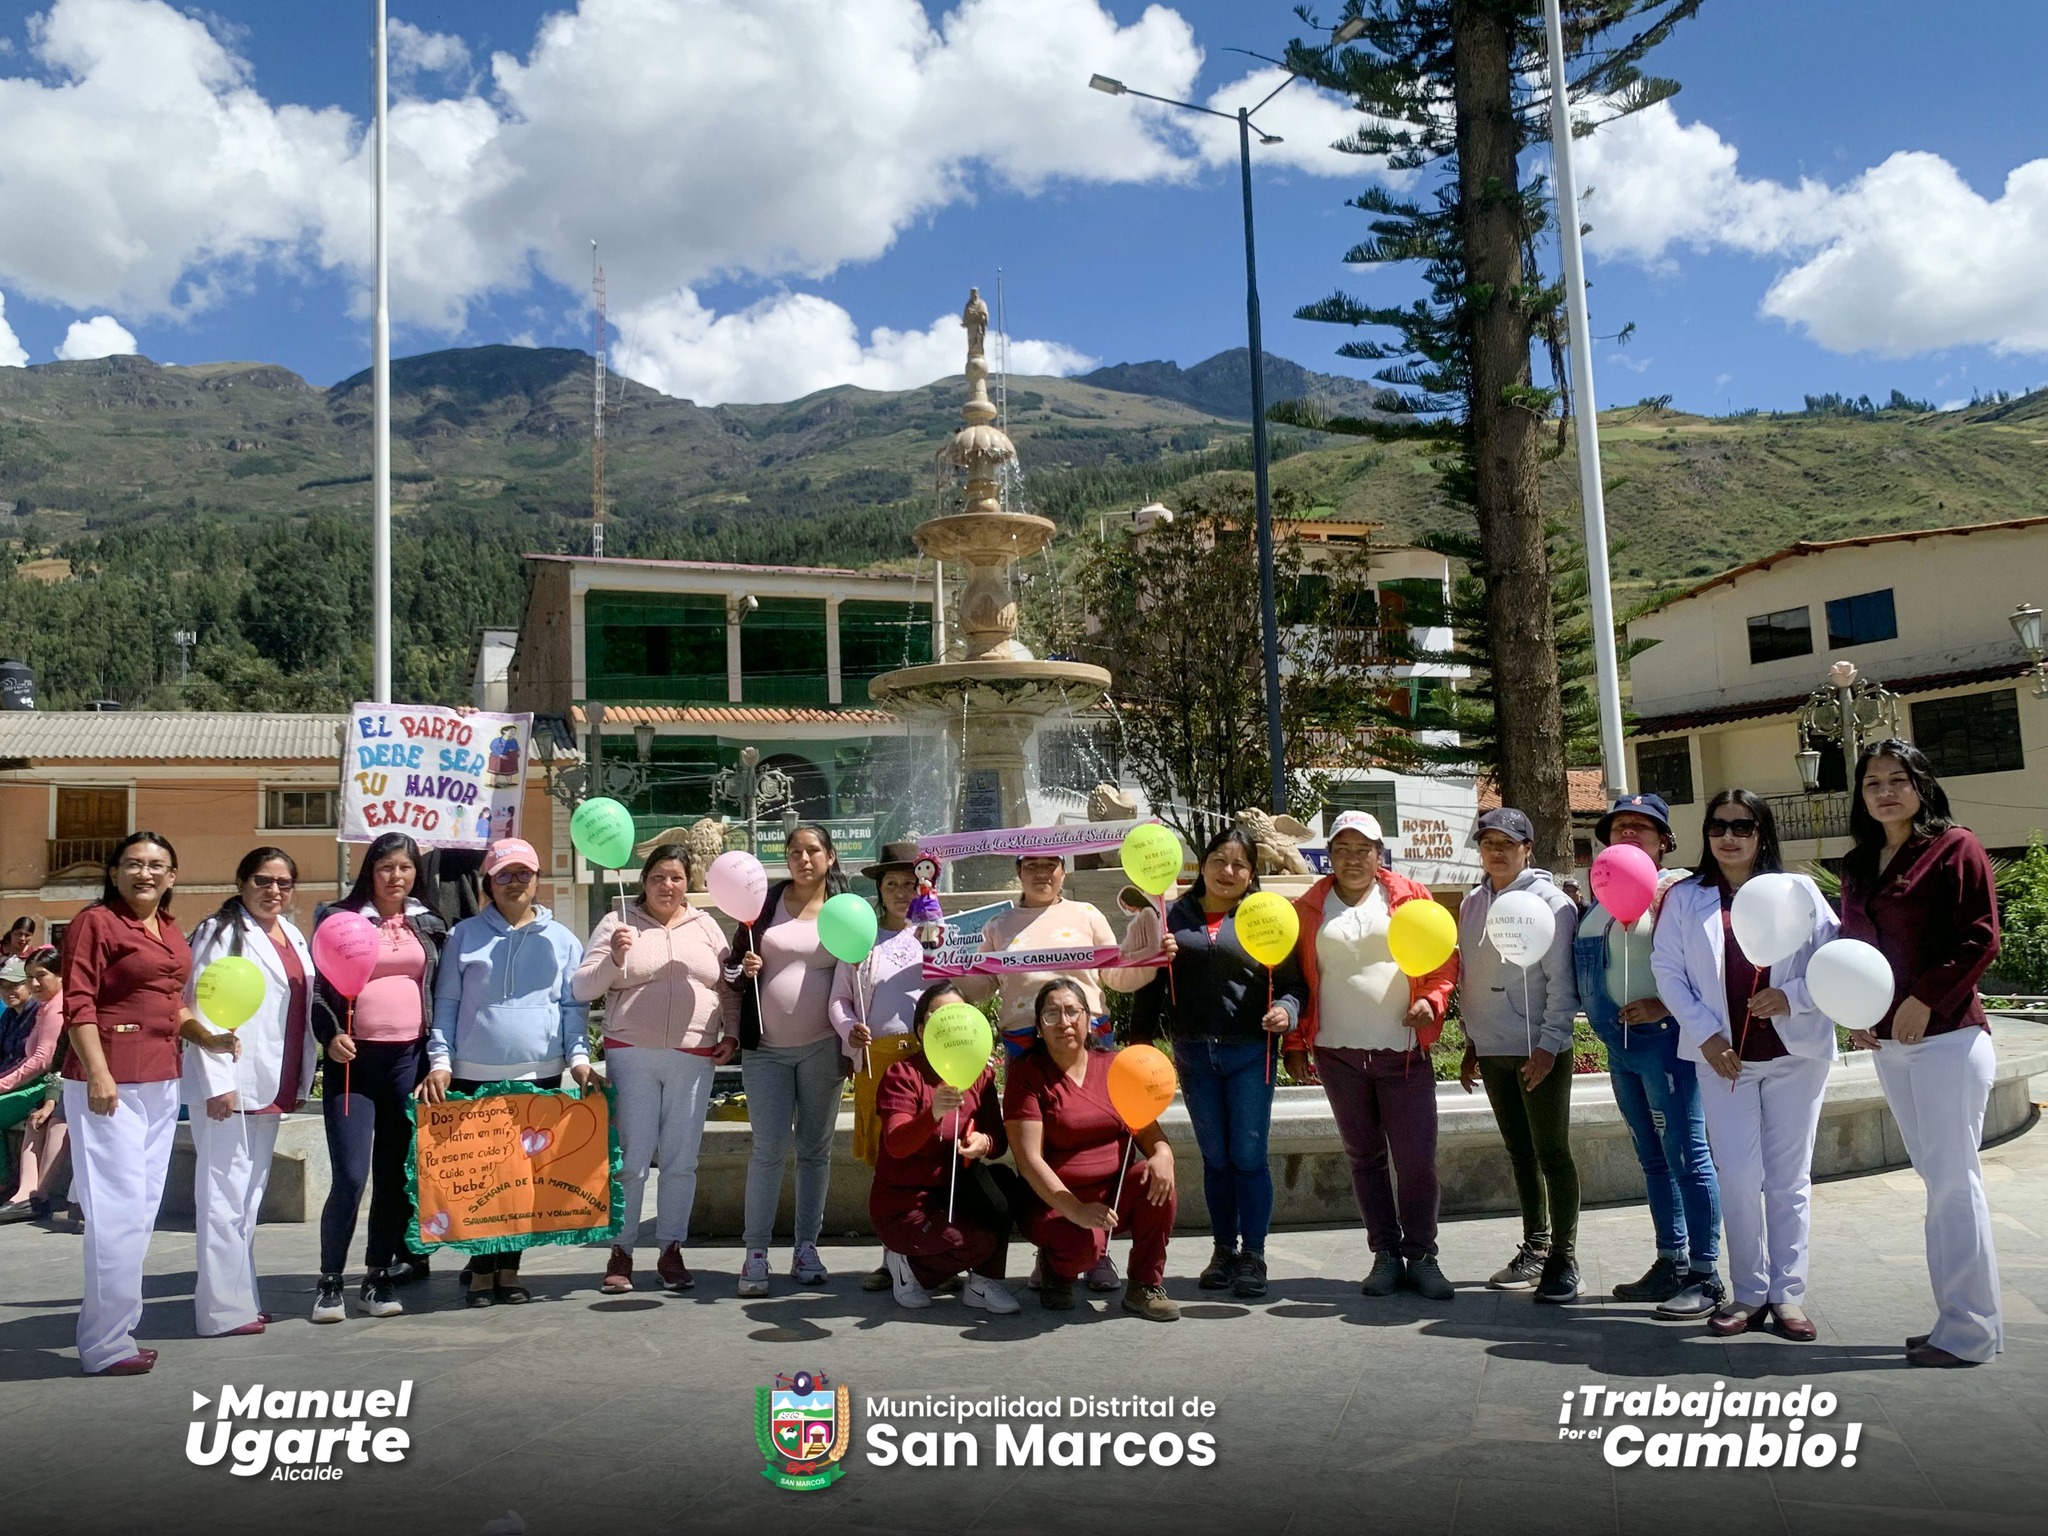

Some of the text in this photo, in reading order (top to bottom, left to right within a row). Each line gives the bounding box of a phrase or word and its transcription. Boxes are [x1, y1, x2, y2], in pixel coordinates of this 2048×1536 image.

[359, 716, 473, 746] EL PARTO
[357, 744, 486, 777] DEBE SER
[354, 771, 478, 805] TU MAYOR
[363, 800, 440, 831] EXITO
[849, 827, 872, 839] PERÚ
[1403, 820, 1449, 832] HOSTAL
[755, 829, 786, 841] OLICÍA
[978, 838, 992, 852] de
[993, 836, 1006, 850] la
[1008, 830, 1084, 850] Maternidad
[1086, 827, 1134, 843] Saluda
[1412, 833, 1452, 846] SANTA
[1404, 846, 1453, 859] HILARIO
[1249, 902, 1268, 912] AMOR
[1495, 916, 1516, 925] AMOR
[1517, 916, 1523, 925] A
[1525, 917, 1536, 925] TU
[945, 931, 983, 946] Semana
[956, 946, 967, 955] de
[1002, 951, 1093, 966] PS. CARHUAYOC
[934, 950, 983, 968] Mayo
[431, 1106, 515, 1126] Dos corazones
[449, 1126, 475, 1143] laten
[478, 1130, 490, 1138] en
[425, 1151, 439, 1168] Por
[477, 1146, 501, 1158] cuido
[469, 1167, 477, 1175] a
[453, 1175, 487, 1195] bebé
[468, 1176, 607, 1213] SEMANA DE LA MATERNIDAD
